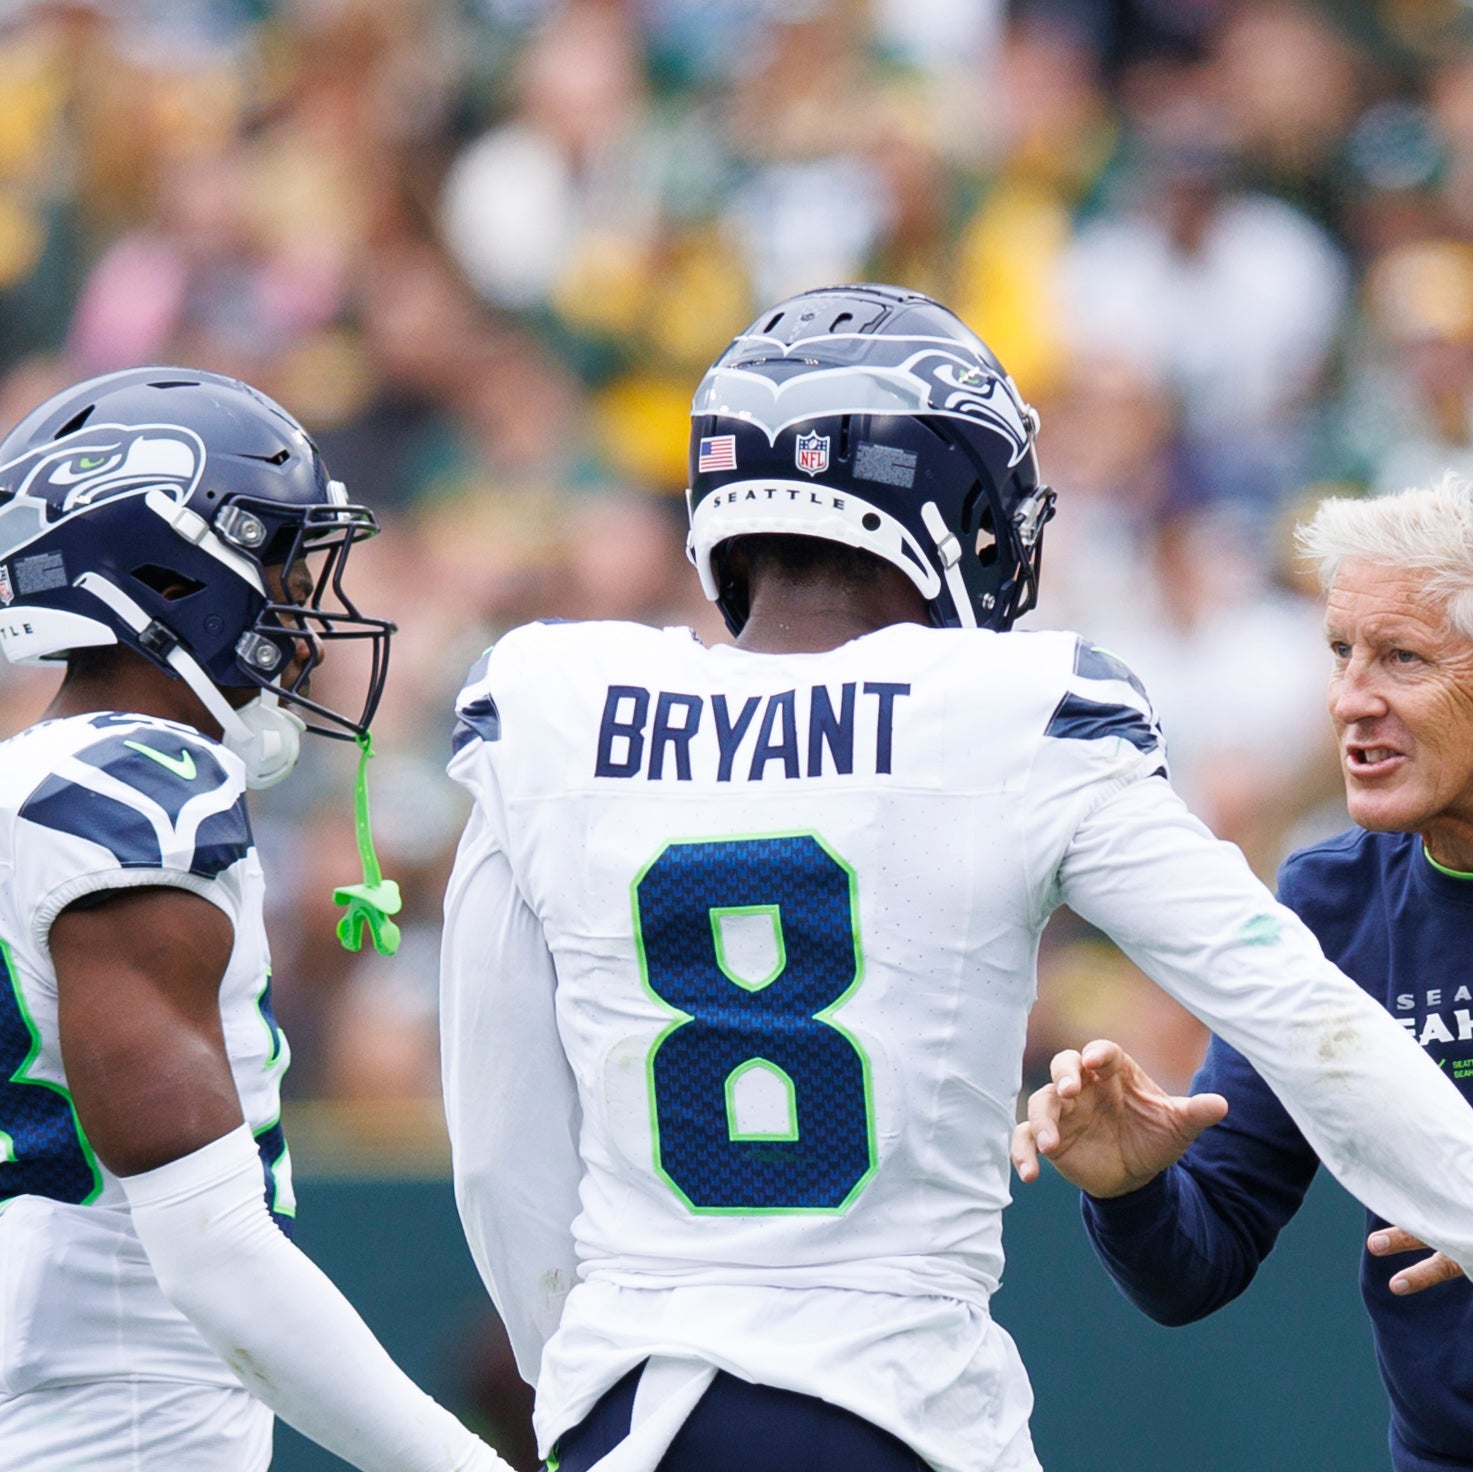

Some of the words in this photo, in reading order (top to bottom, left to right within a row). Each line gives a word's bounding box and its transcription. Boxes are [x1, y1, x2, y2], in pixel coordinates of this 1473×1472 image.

[800, 452, 824, 468] NFL
[714, 489, 845, 510] SEATTLE
[594, 681, 912, 783] BRYANT
[630, 828, 878, 1216] 8
